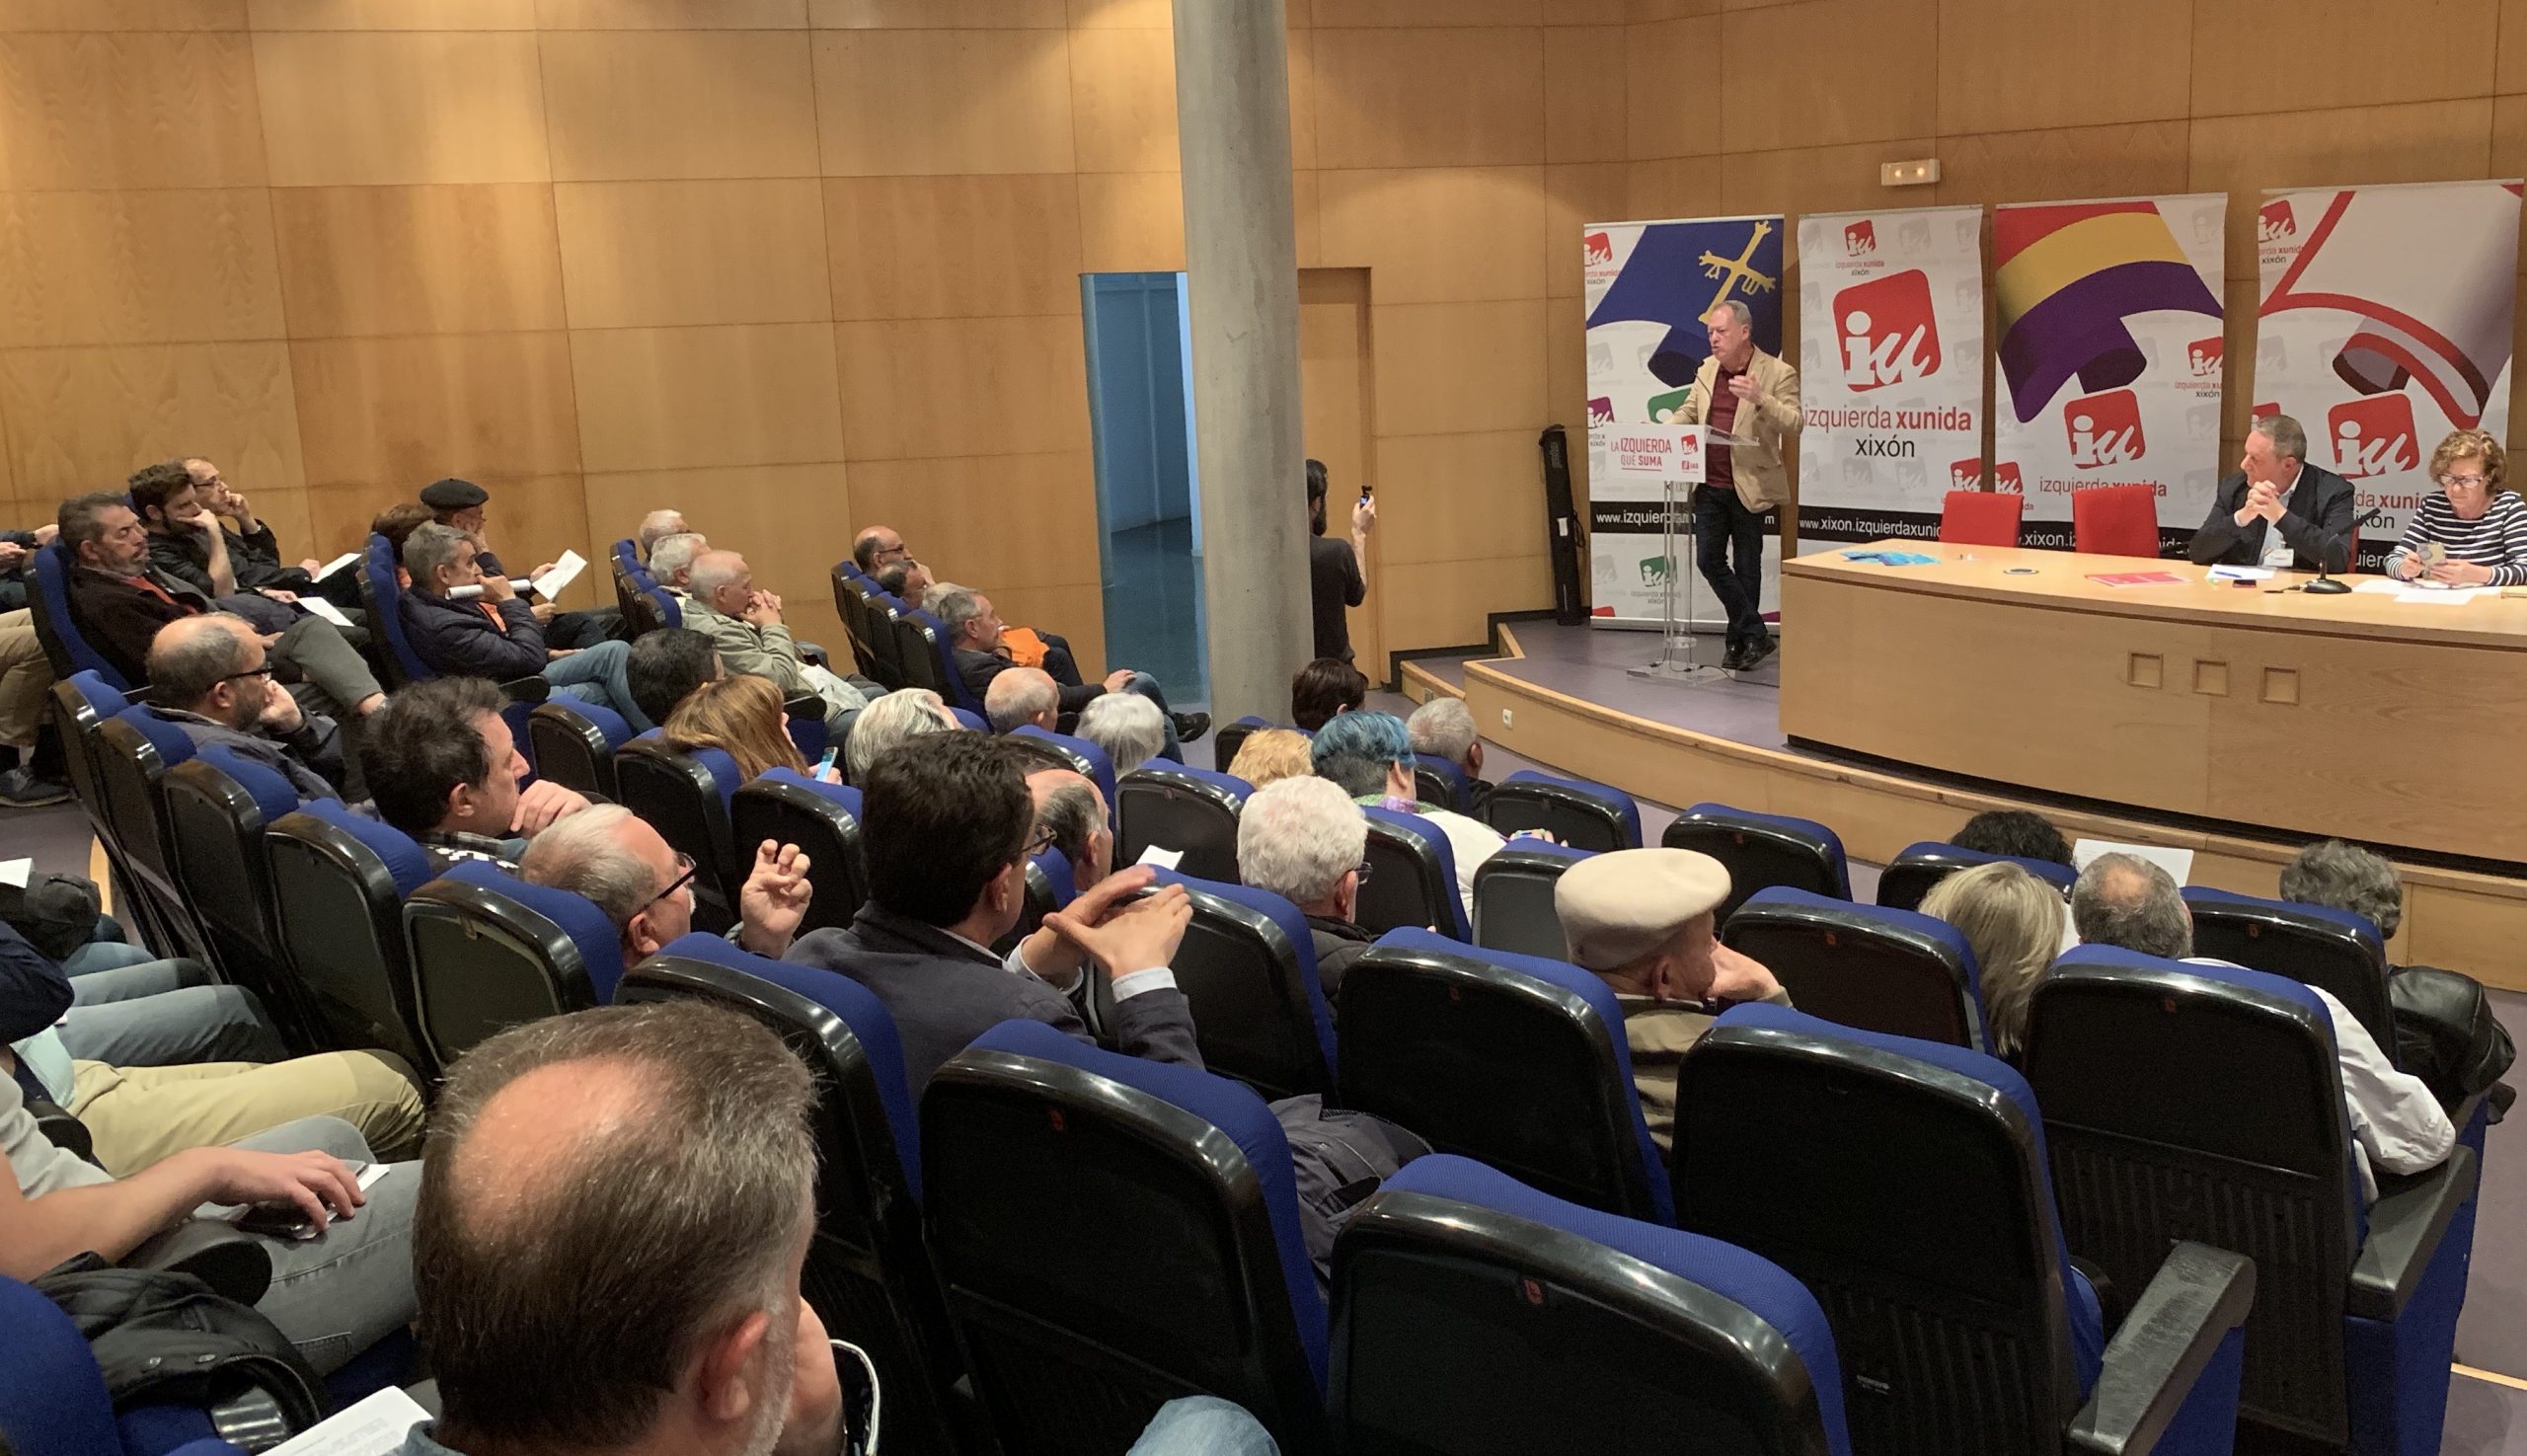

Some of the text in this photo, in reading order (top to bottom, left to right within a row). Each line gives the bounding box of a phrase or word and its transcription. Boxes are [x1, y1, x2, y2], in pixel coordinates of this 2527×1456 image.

[1804, 404, 1972, 433] izquierda xunida
[1610, 437, 1673, 454] LA IZQUIERDA
[1855, 434, 1916, 458] xixón
[1621, 455, 1663, 467] QUE SUMA
